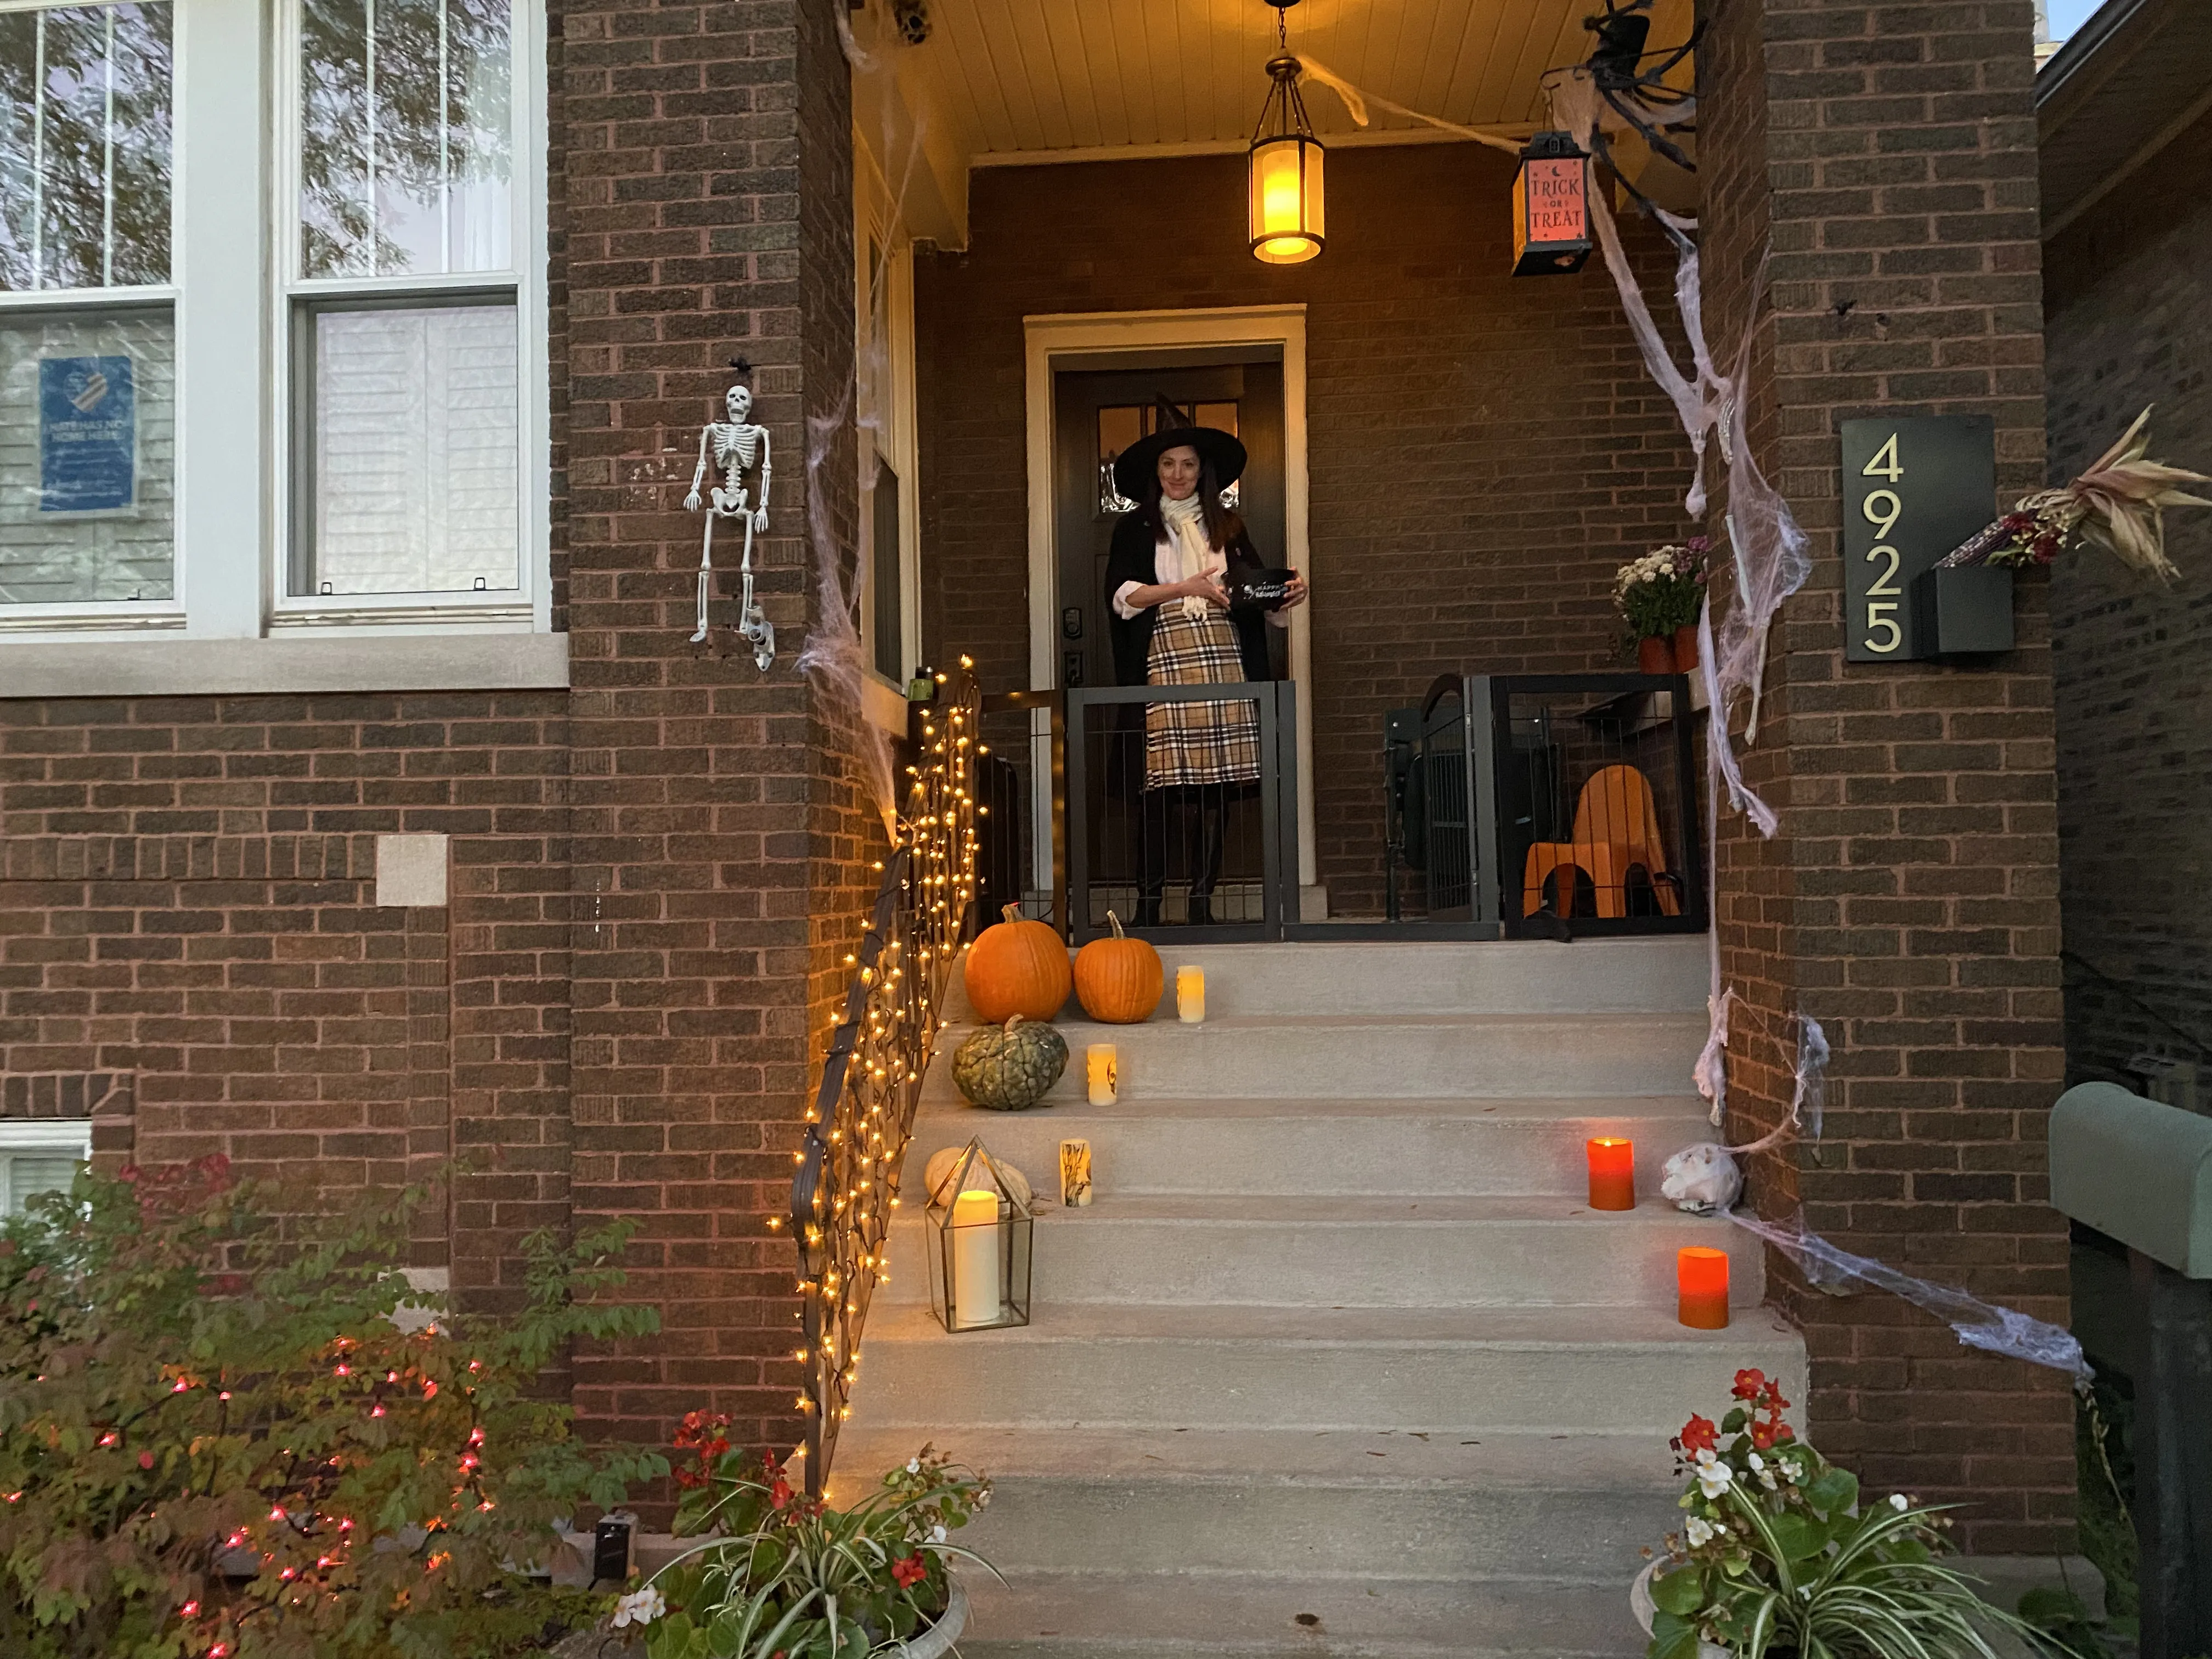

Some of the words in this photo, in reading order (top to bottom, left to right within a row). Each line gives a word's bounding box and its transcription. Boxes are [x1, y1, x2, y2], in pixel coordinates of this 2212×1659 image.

[1531, 179, 1581, 198] TRICK
[1531, 210, 1582, 228] TREAT
[1863, 432, 1904, 653] 4925
